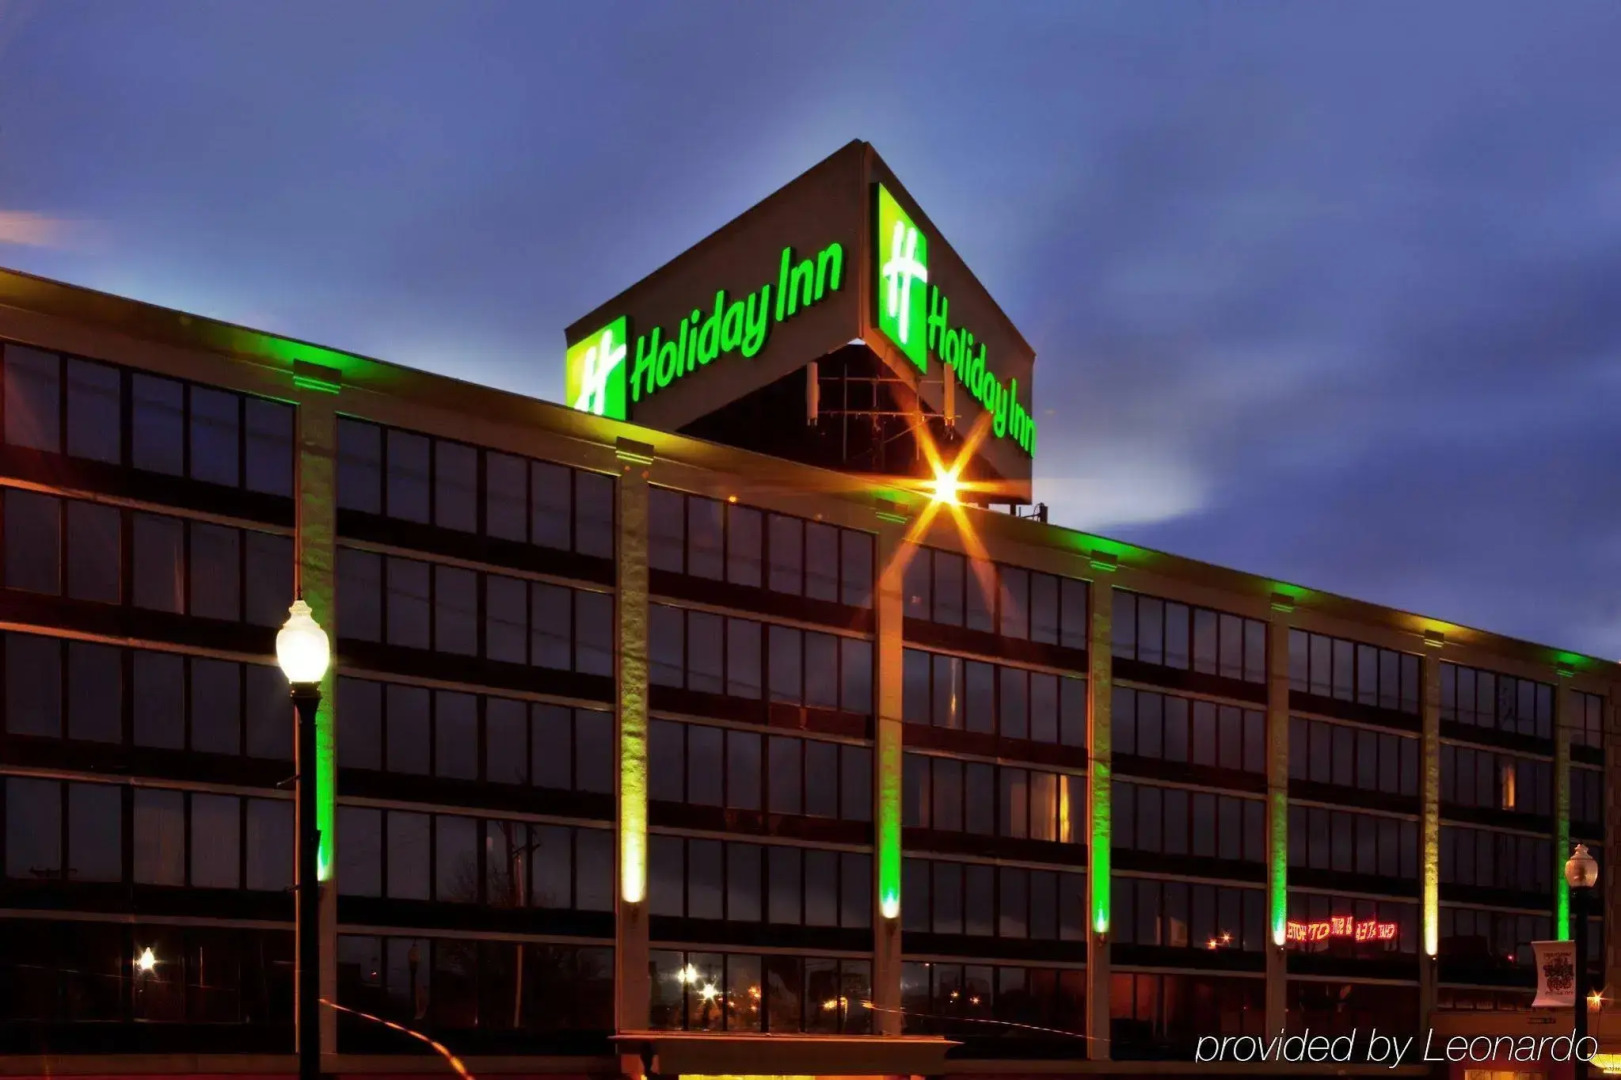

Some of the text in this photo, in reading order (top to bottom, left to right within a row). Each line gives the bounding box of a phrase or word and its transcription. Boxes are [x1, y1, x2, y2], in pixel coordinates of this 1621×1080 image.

[630, 243, 842, 401] Holiday Inn
[928, 285, 1036, 459] Holiday Inn
